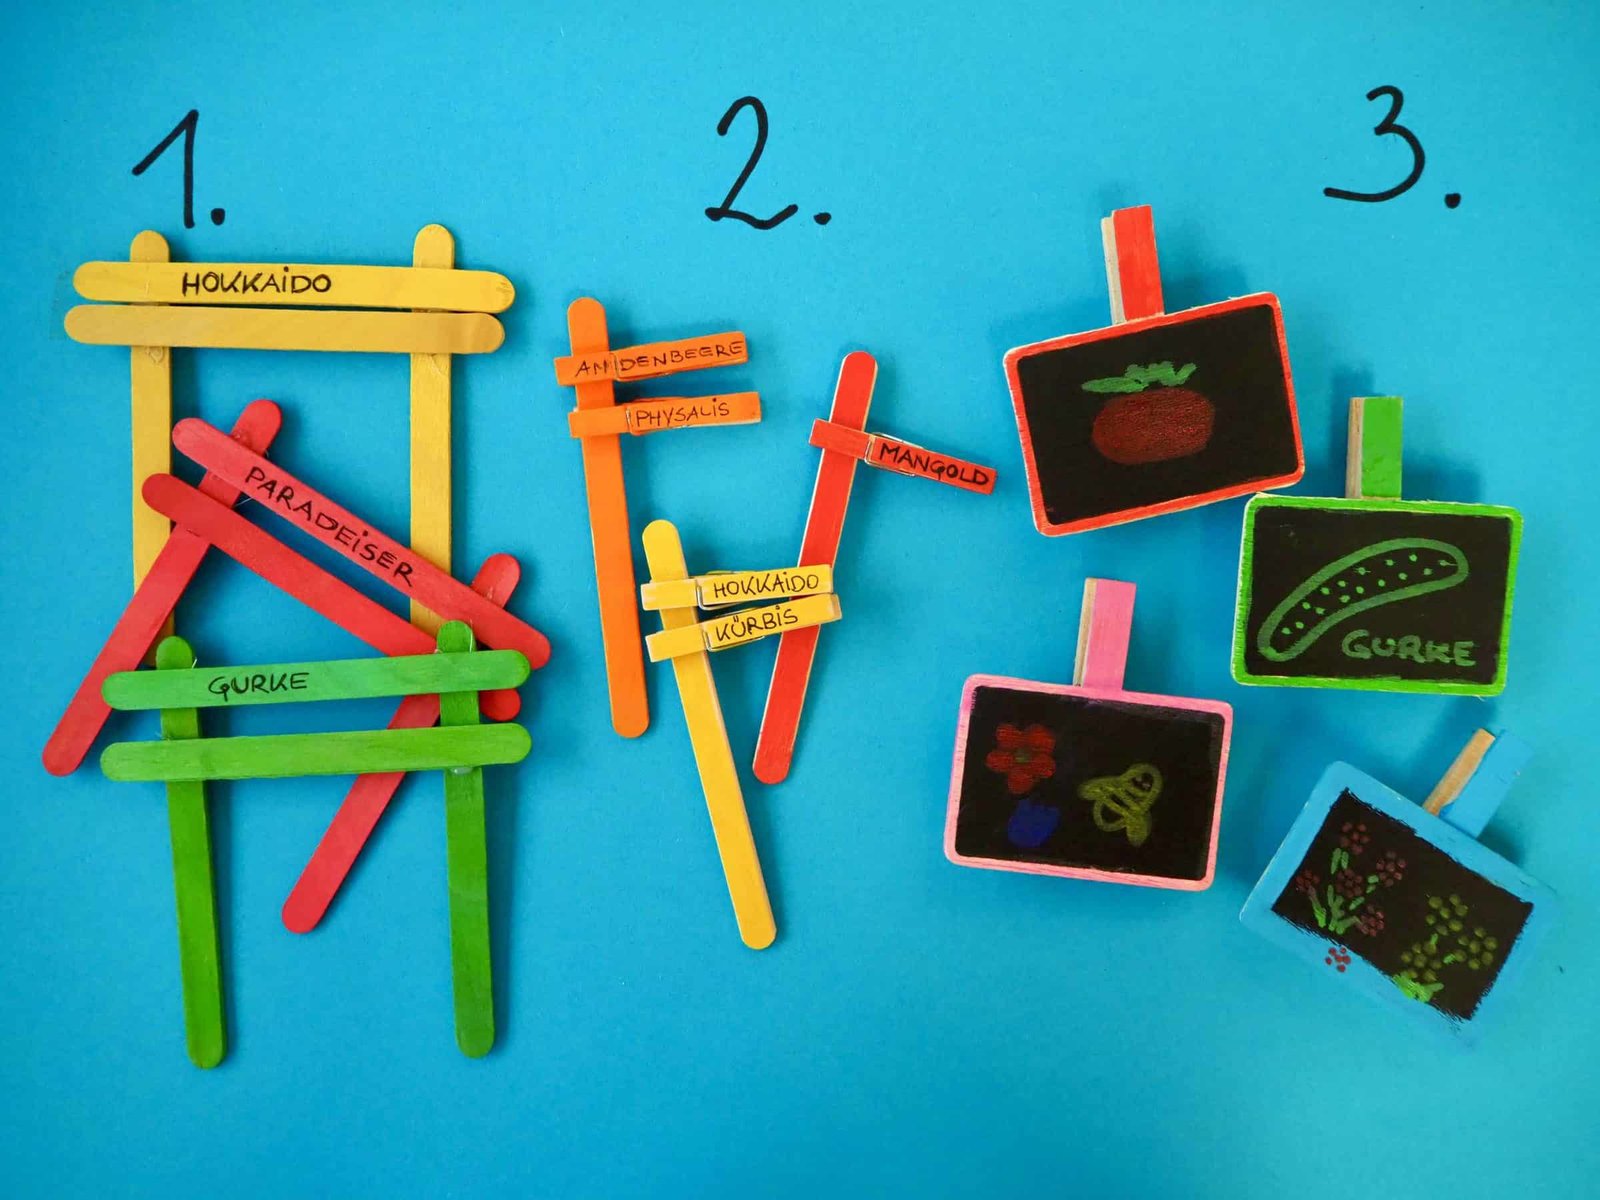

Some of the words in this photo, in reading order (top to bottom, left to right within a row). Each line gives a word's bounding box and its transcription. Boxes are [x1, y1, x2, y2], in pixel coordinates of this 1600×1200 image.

[132, 109, 227, 229] 1.
[705, 95, 832, 230] 2.
[1323, 85, 1461, 209] 3.
[880, 442, 989, 485] MANGOLD
[208, 672, 310, 702] GURKE
[1341, 629, 1476, 666] GURKE
